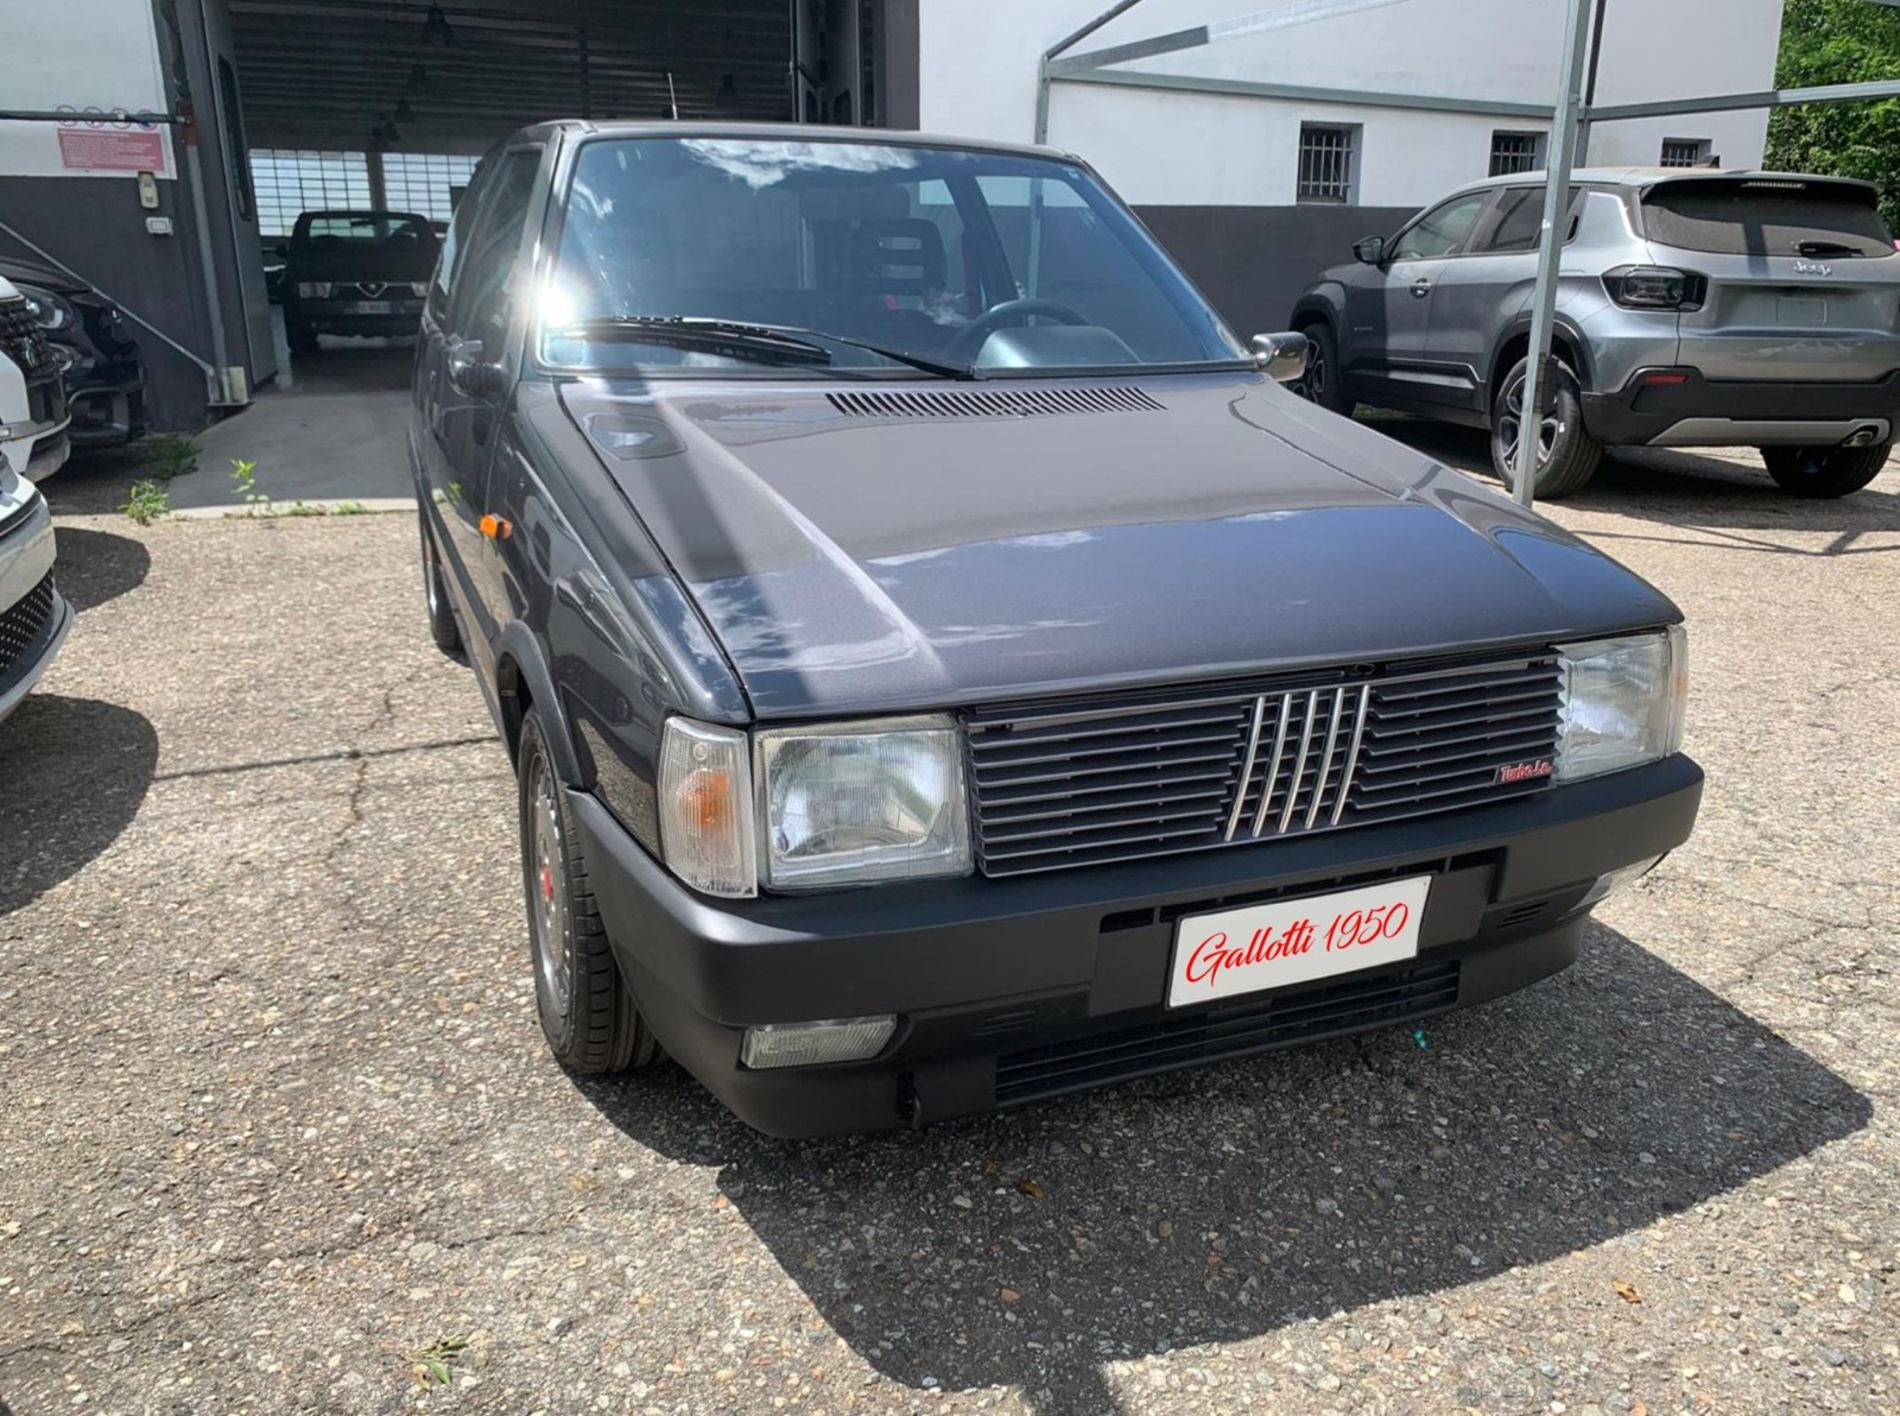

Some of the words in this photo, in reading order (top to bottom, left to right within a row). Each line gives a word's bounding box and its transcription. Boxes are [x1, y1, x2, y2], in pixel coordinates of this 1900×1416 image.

[1793, 260, 1831, 277] Jeep
[1185, 919, 1318, 987] Gallotti
[1324, 902, 1409, 952] 1950
